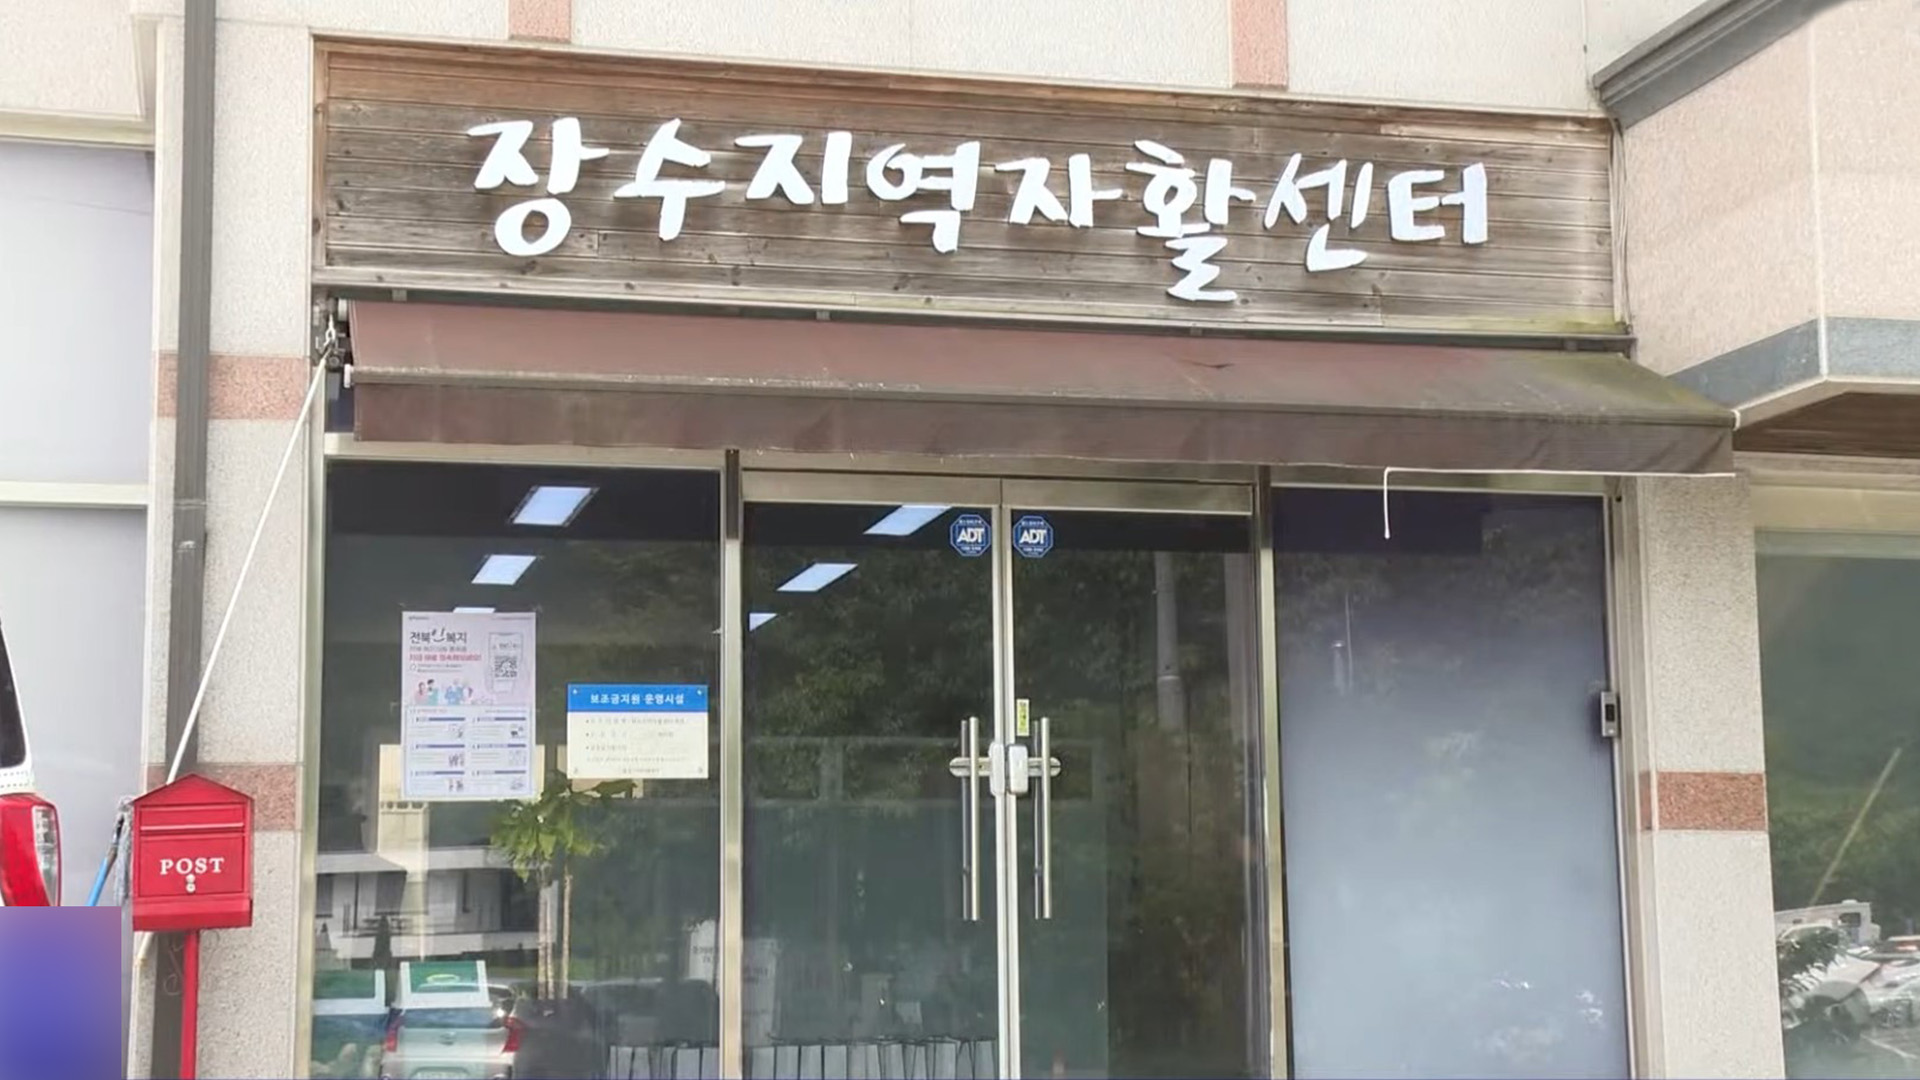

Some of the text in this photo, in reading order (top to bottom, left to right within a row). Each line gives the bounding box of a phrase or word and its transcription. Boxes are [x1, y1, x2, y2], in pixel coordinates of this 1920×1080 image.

[467, 117, 1488, 302] 장수지역자활센터
[957, 527, 985, 543] ADT
[1020, 529, 1047, 544] ADT
[590, 693, 685, 705] 보조금지원 운영시설
[160, 857, 225, 875] POST
